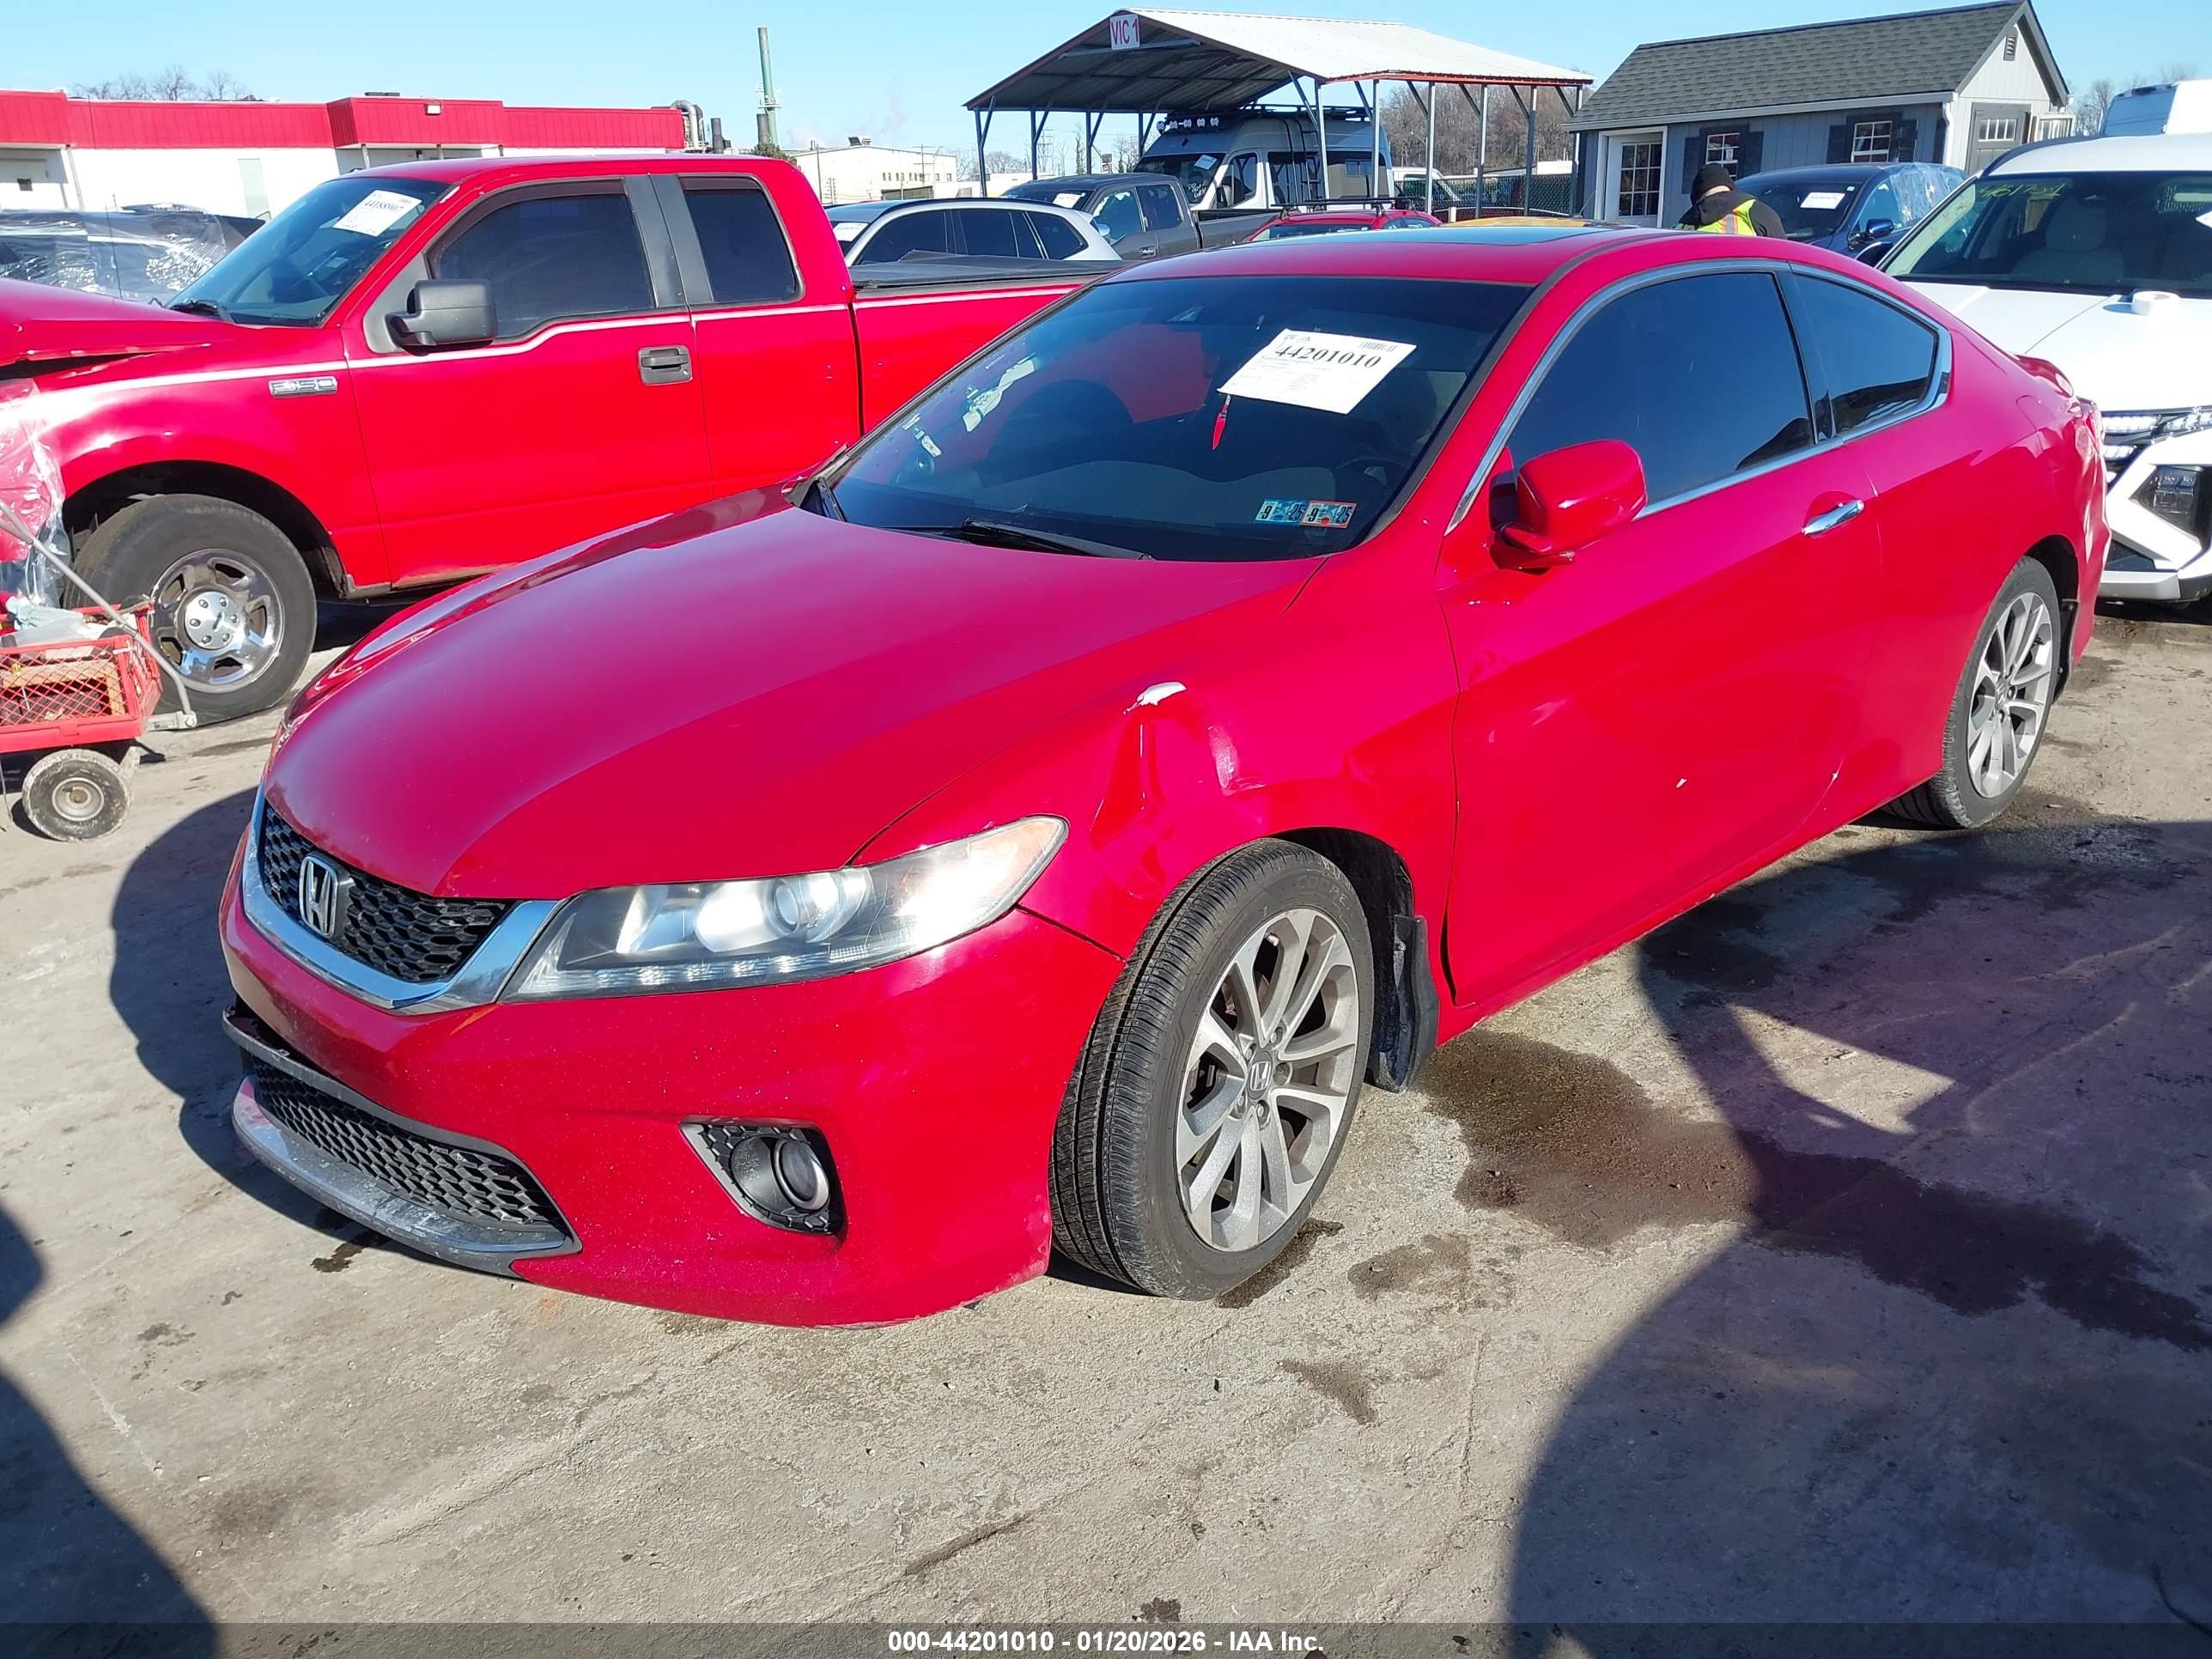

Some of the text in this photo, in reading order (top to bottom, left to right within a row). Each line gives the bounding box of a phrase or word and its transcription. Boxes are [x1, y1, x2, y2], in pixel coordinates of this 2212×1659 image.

[1110, 18, 1139, 45] VIC 1
[1274, 344, 1382, 368] 44201010
